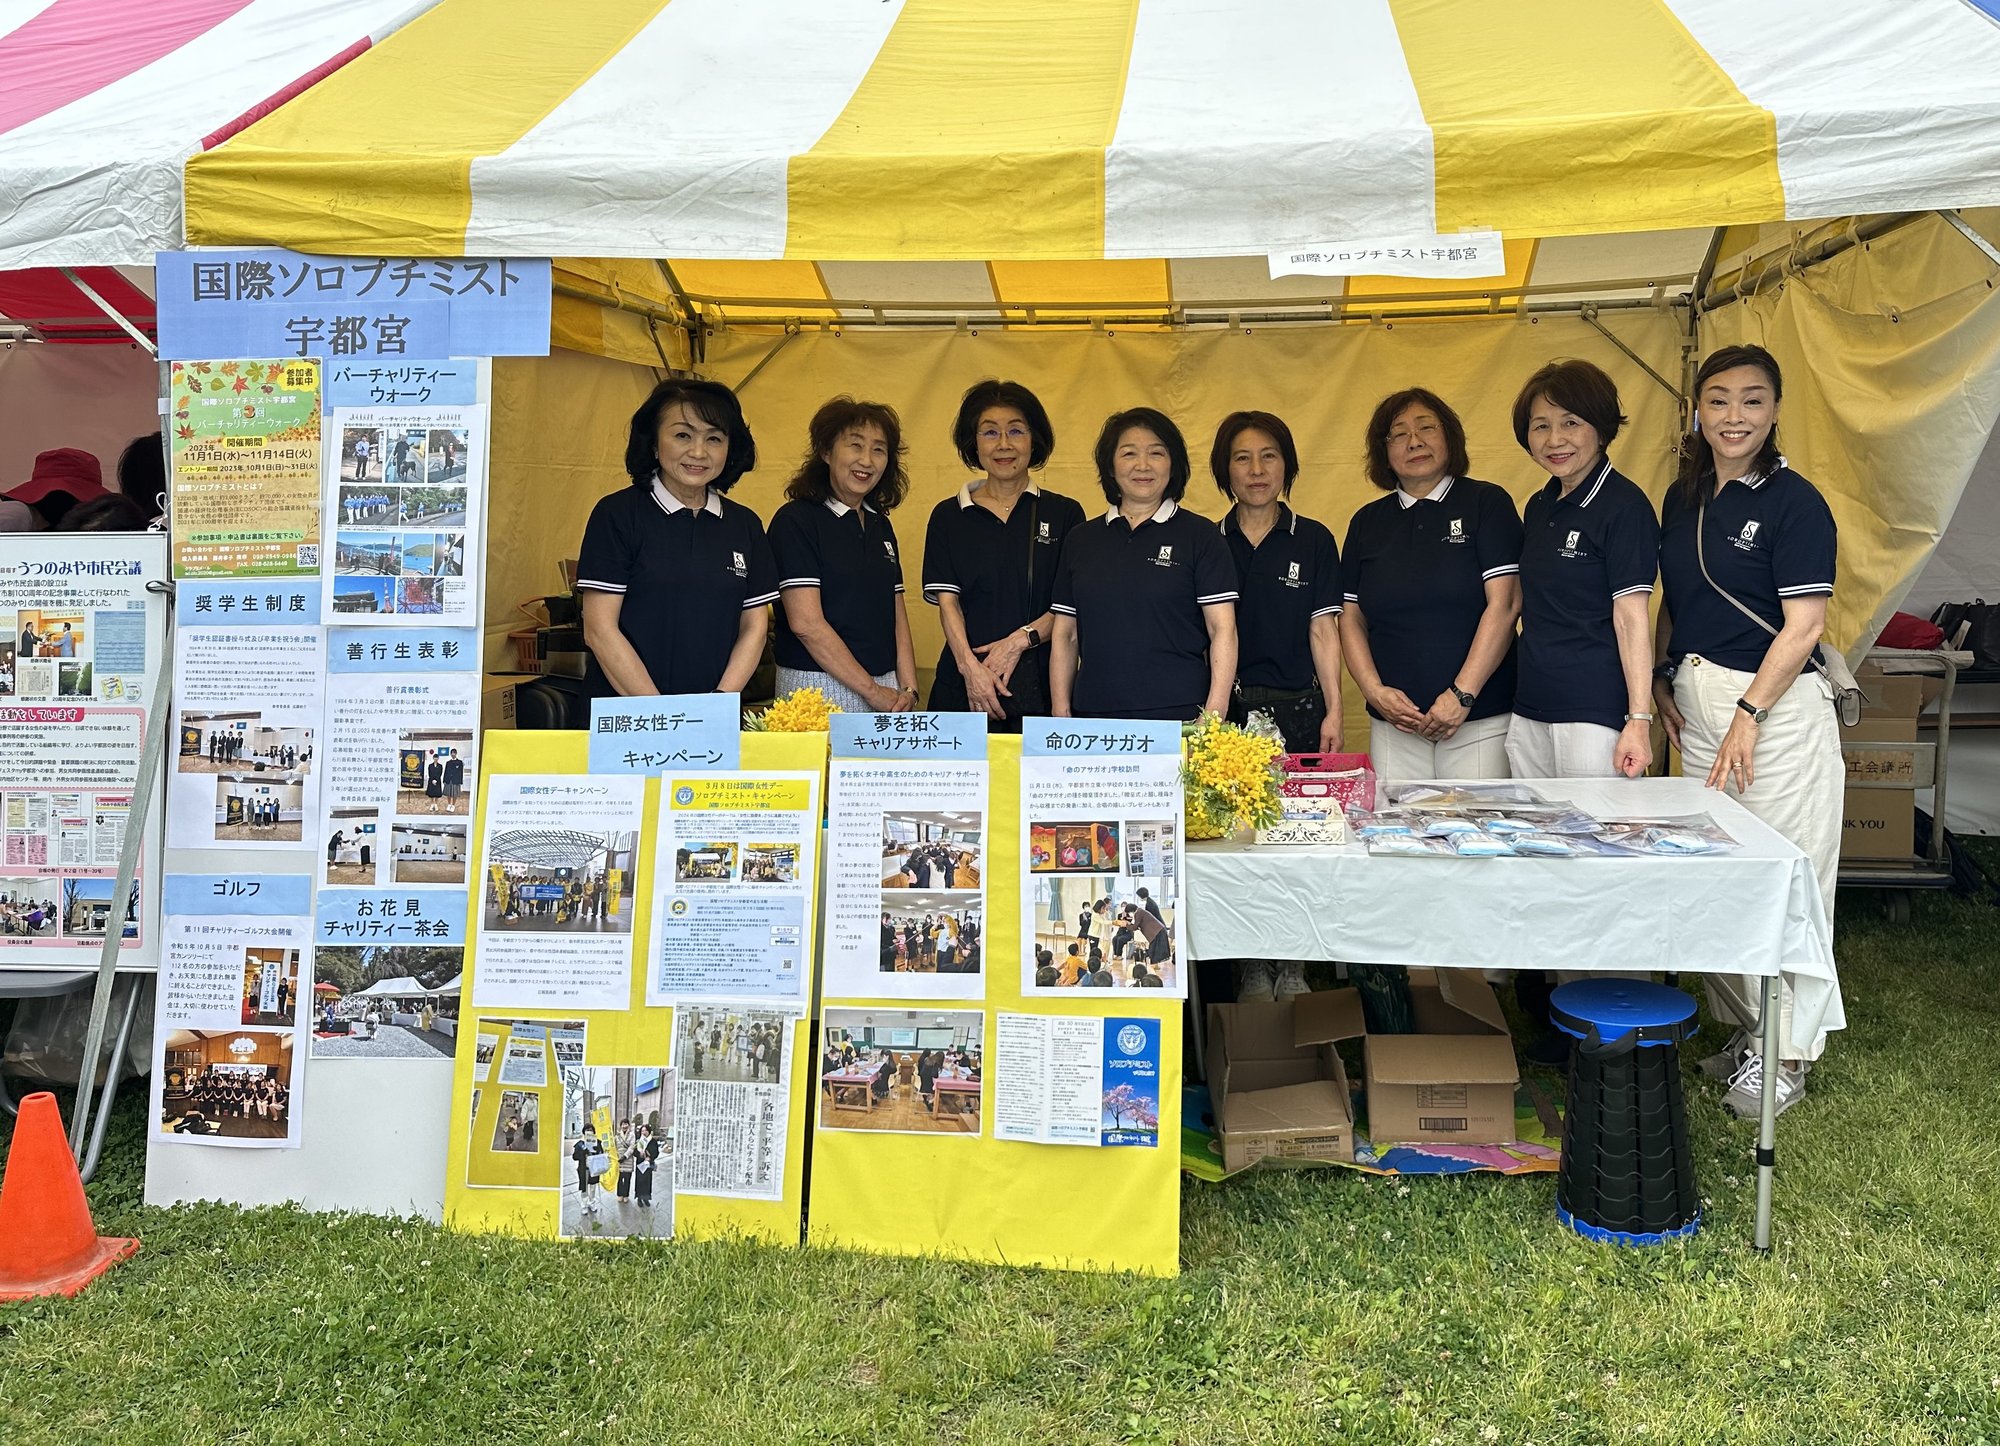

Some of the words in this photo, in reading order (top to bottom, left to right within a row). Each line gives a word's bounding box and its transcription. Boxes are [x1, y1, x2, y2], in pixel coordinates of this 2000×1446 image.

[1291, 247, 1478, 264] 国際ソロプチミスト宇都宮
[192, 258, 520, 302] 国際ソロプチミスト
[284, 313, 412, 357] 宇都宮
[286, 368, 313, 377] 参加者
[286, 377, 313, 386] 募集中
[334, 366, 457, 384] バーチャリティー
[370, 386, 432, 403] ウォーク
[226, 437, 263, 447] 開催期間
[18, 560, 142, 576] うつのみや市民会議
[195, 594, 306, 613] 奨学生制度
[346, 641, 459, 661] 善行生表彰
[597, 713, 704, 733] 国際女性デー
[874, 714, 940, 732] 夢を拓く
[853, 736, 962, 750] キャリアサポート
[1045, 731, 1155, 753] 命のアサガオ
[623, 748, 723, 768] キャンペーン
[520, 786, 609, 795] 国際女性デーキャンペーン
[1860, 819, 1885, 829] YOU
[213, 879, 261, 897] ゴルフ
[357, 899, 421, 917] お花見
[324, 919, 450, 938] チャリティー茶会
